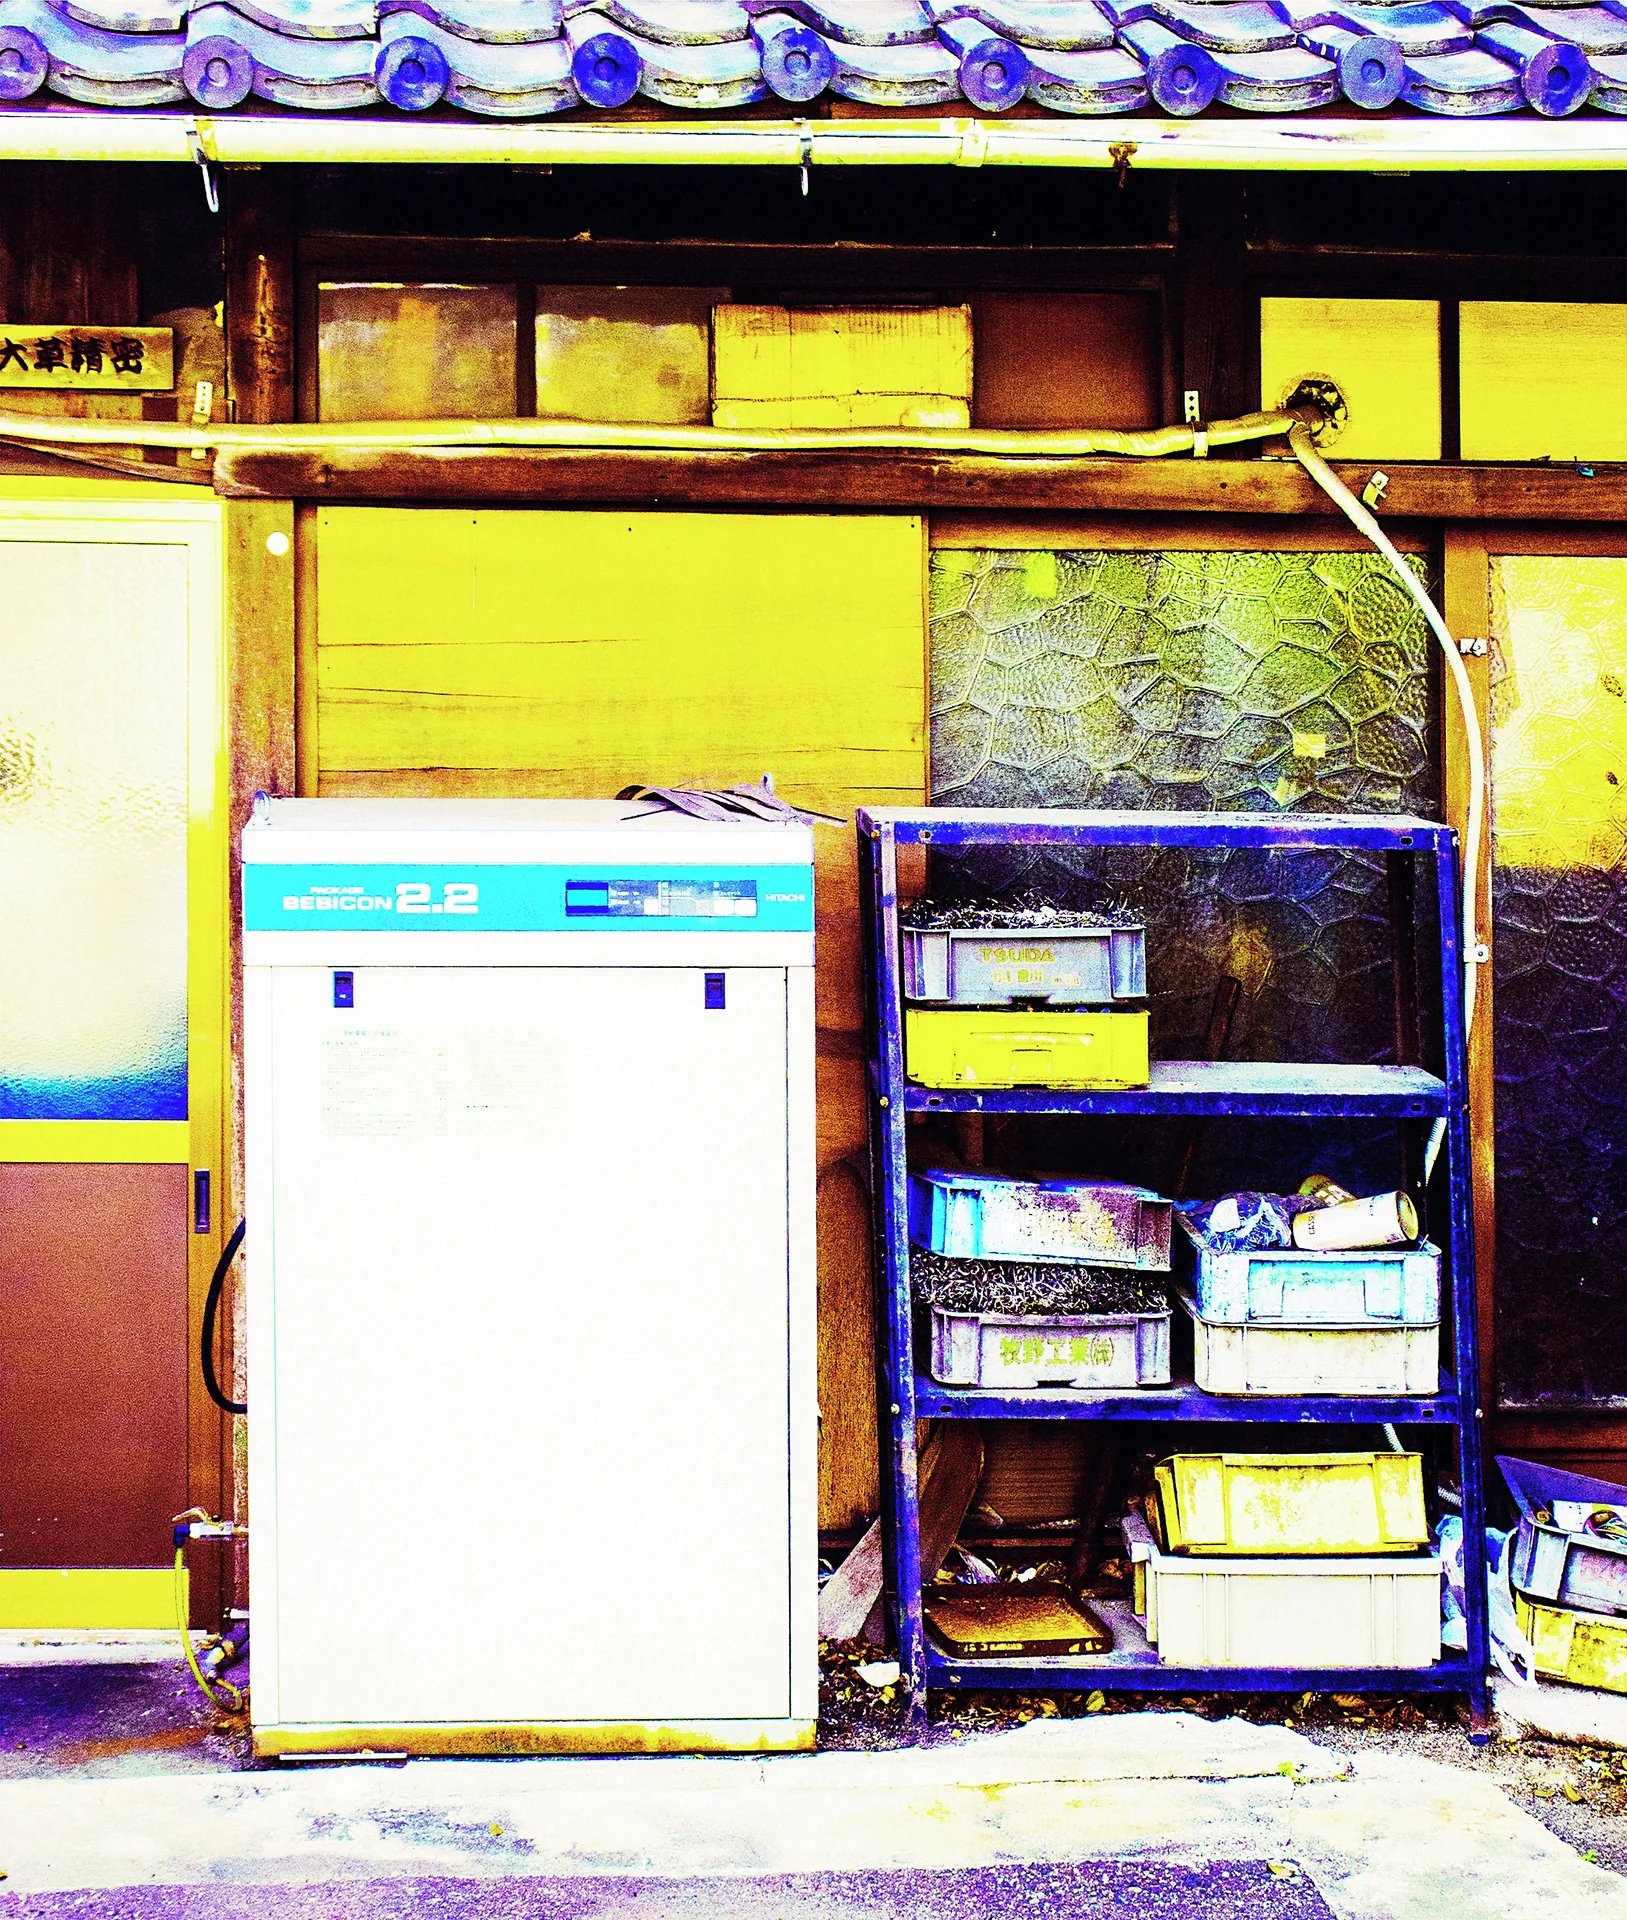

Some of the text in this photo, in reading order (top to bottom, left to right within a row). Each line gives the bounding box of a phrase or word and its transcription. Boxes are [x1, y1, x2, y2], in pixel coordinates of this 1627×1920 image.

[309, 886, 365, 895] PACKAGE
[283, 882, 479, 914] BEBICON 2.2
[765, 893, 806, 903] HITACHI
[979, 947, 1056, 964] TSUDA
